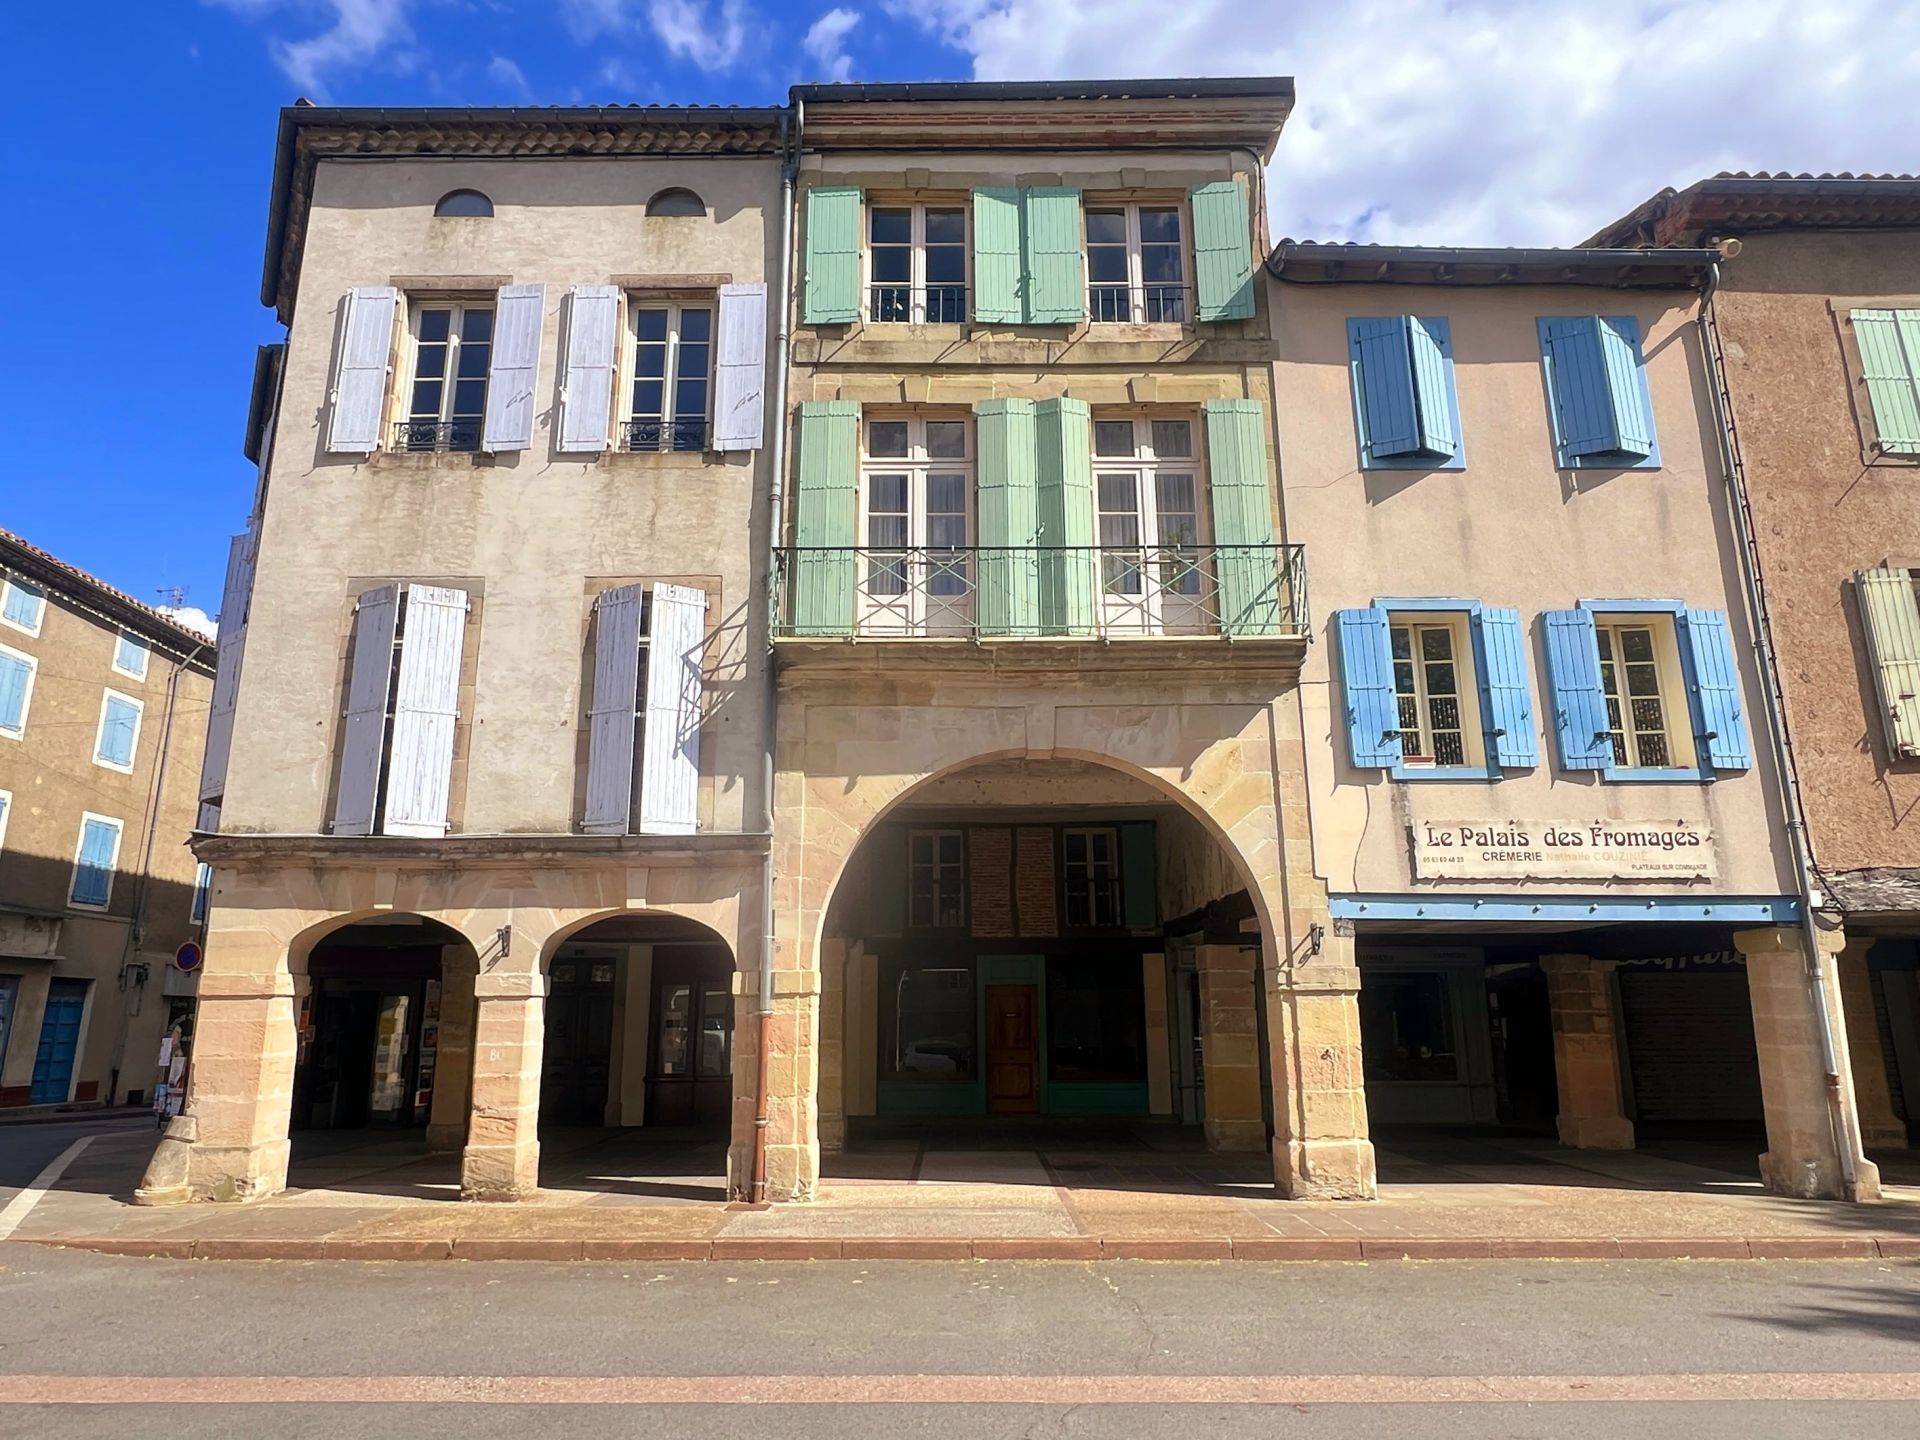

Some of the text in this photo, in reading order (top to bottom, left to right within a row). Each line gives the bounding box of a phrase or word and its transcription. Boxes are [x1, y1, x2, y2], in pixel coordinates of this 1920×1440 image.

[1426, 826, 1700, 850] Le Palais des Fromages
[1482, 850, 1543, 862] CRÉMERIE
